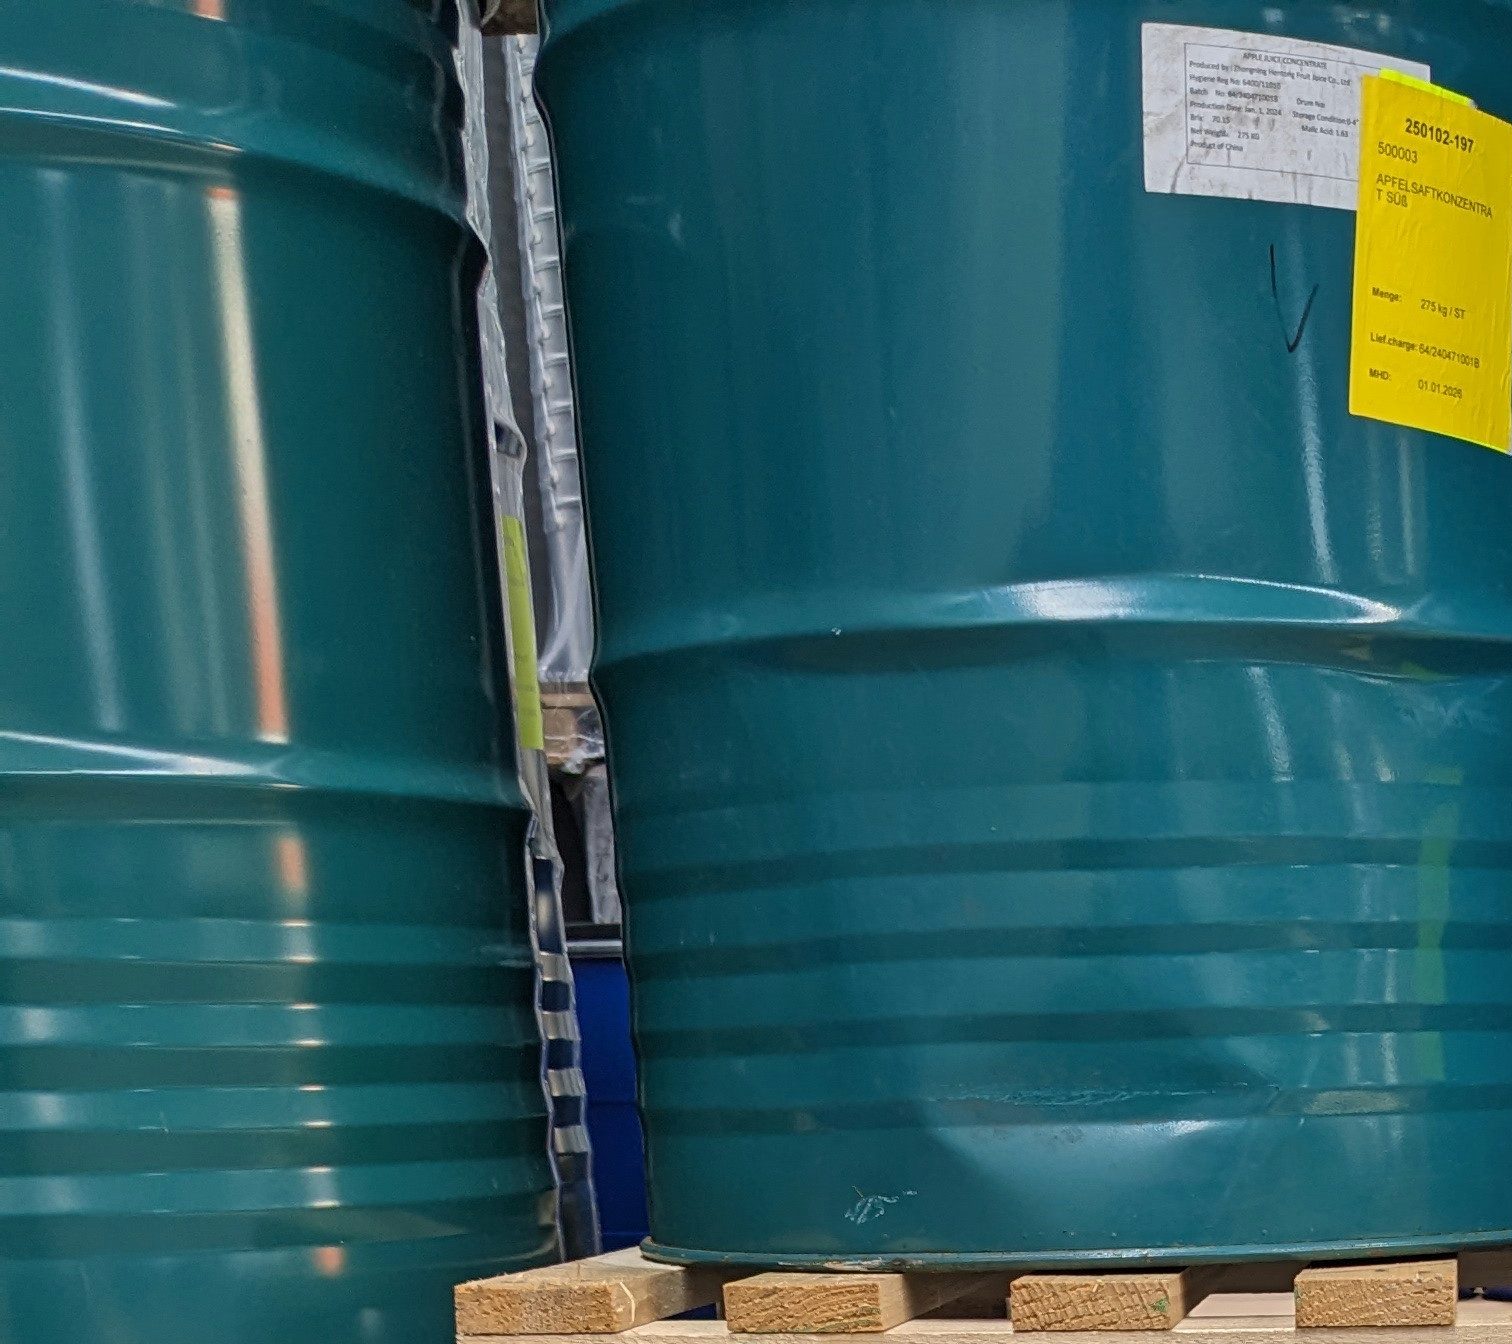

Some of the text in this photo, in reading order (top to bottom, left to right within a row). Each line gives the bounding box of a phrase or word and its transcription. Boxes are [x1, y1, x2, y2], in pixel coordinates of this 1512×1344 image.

[1404, 118, 1474, 153] 250102-197
[1378, 141, 1418, 164] 500003
[1376, 189, 1382, 201] T
[1376, 173, 1493, 218] APFELSAFTKONZENTRA
[1420, 299, 1436, 312] 275
[1438, 303, 1448, 317] kg
[1454, 308, 1466, 319] ST
